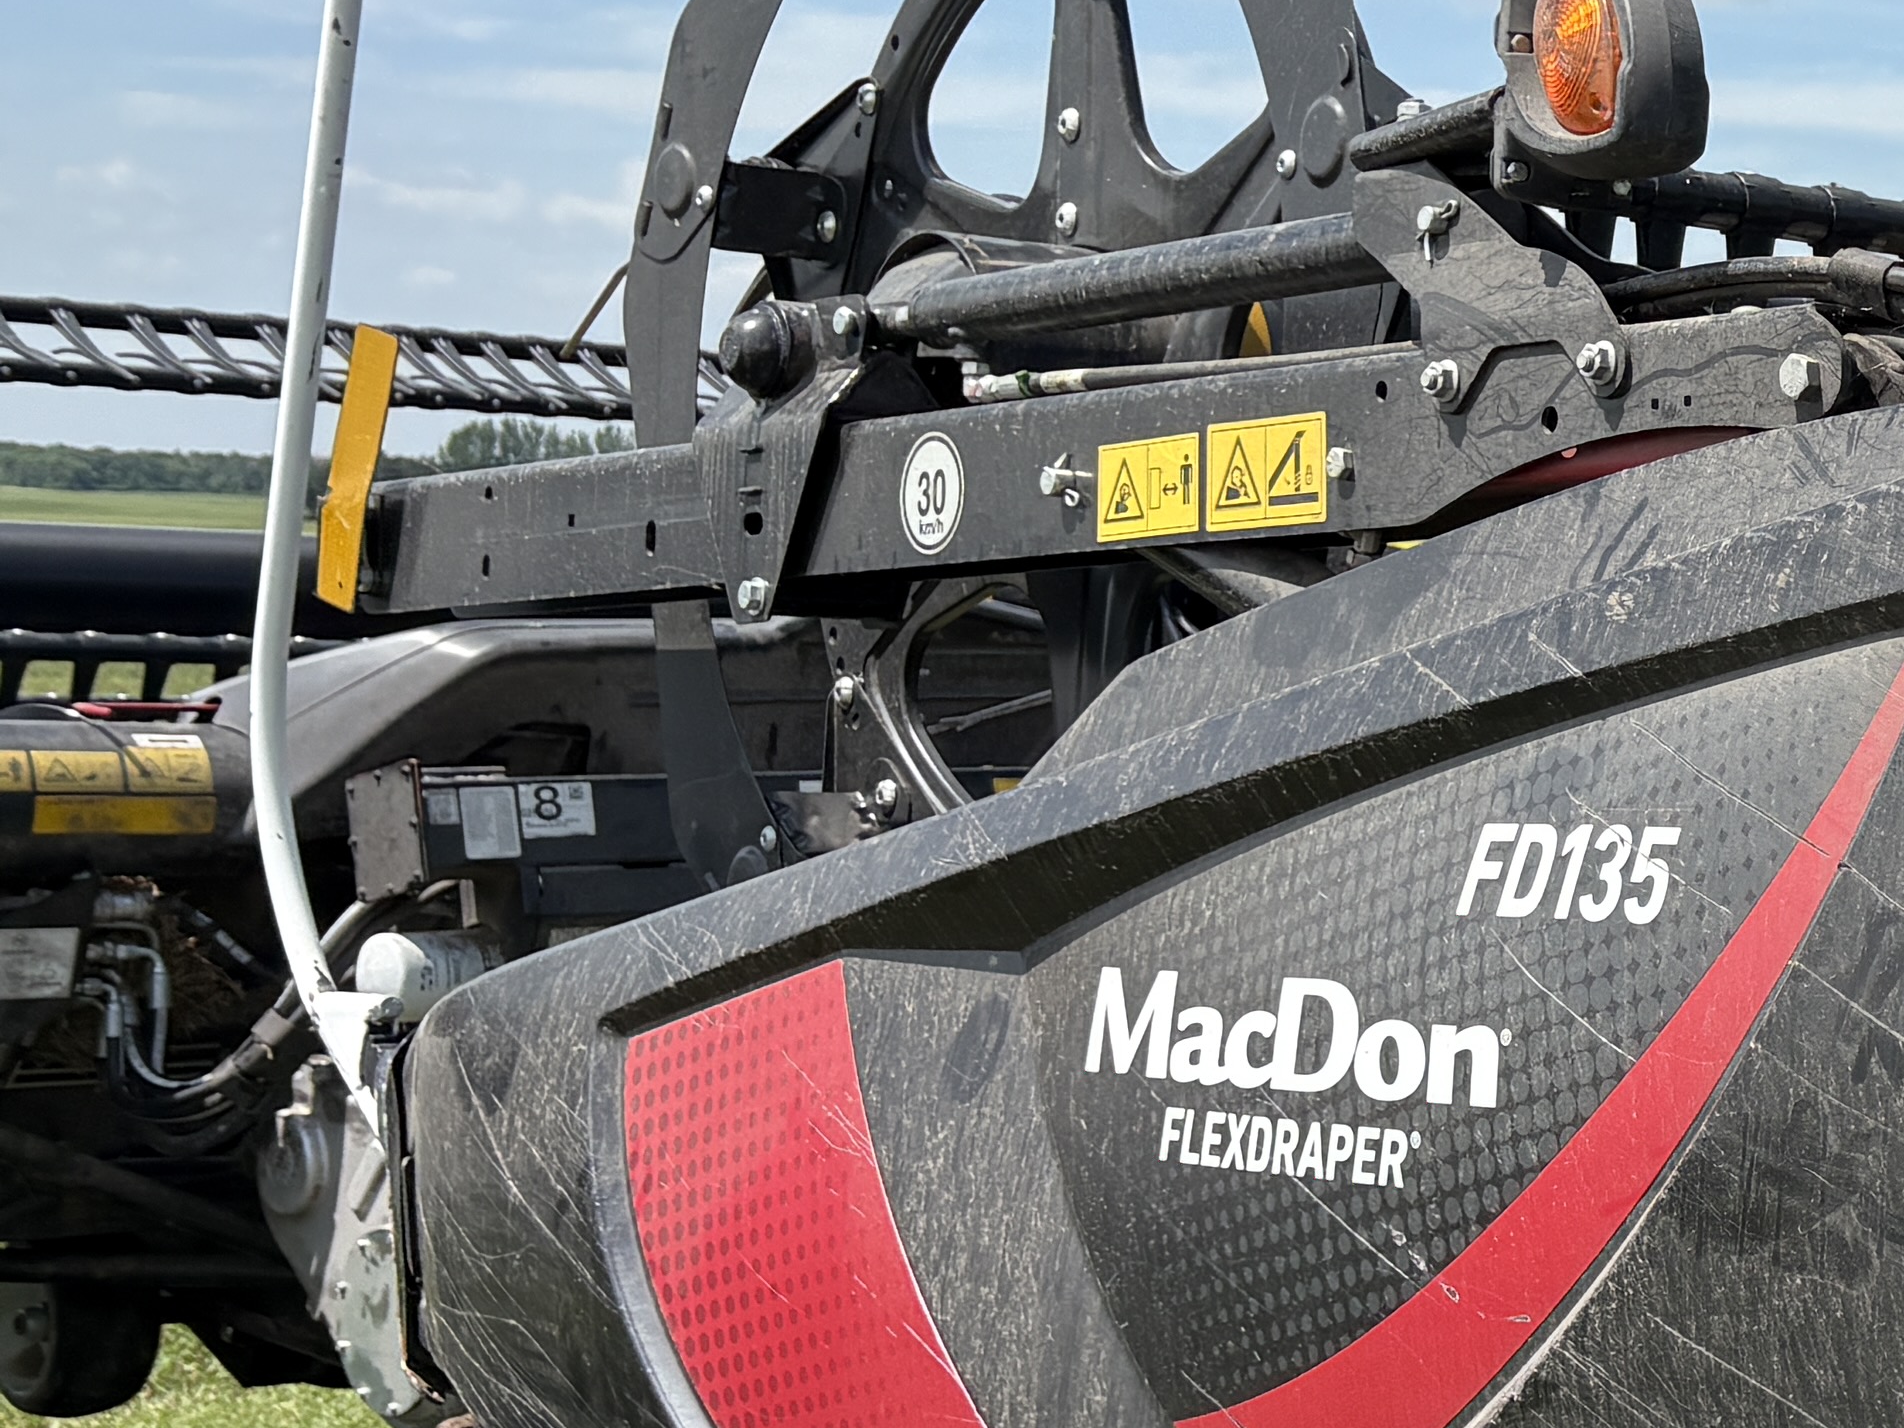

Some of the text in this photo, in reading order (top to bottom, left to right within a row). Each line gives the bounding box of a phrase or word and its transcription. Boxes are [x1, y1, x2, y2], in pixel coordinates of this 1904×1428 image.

[918, 469, 946, 517] 30
[919, 518, 944, 535] km/h
[534, 785, 563, 821] 8
[1455, 822, 1683, 925] FD135
